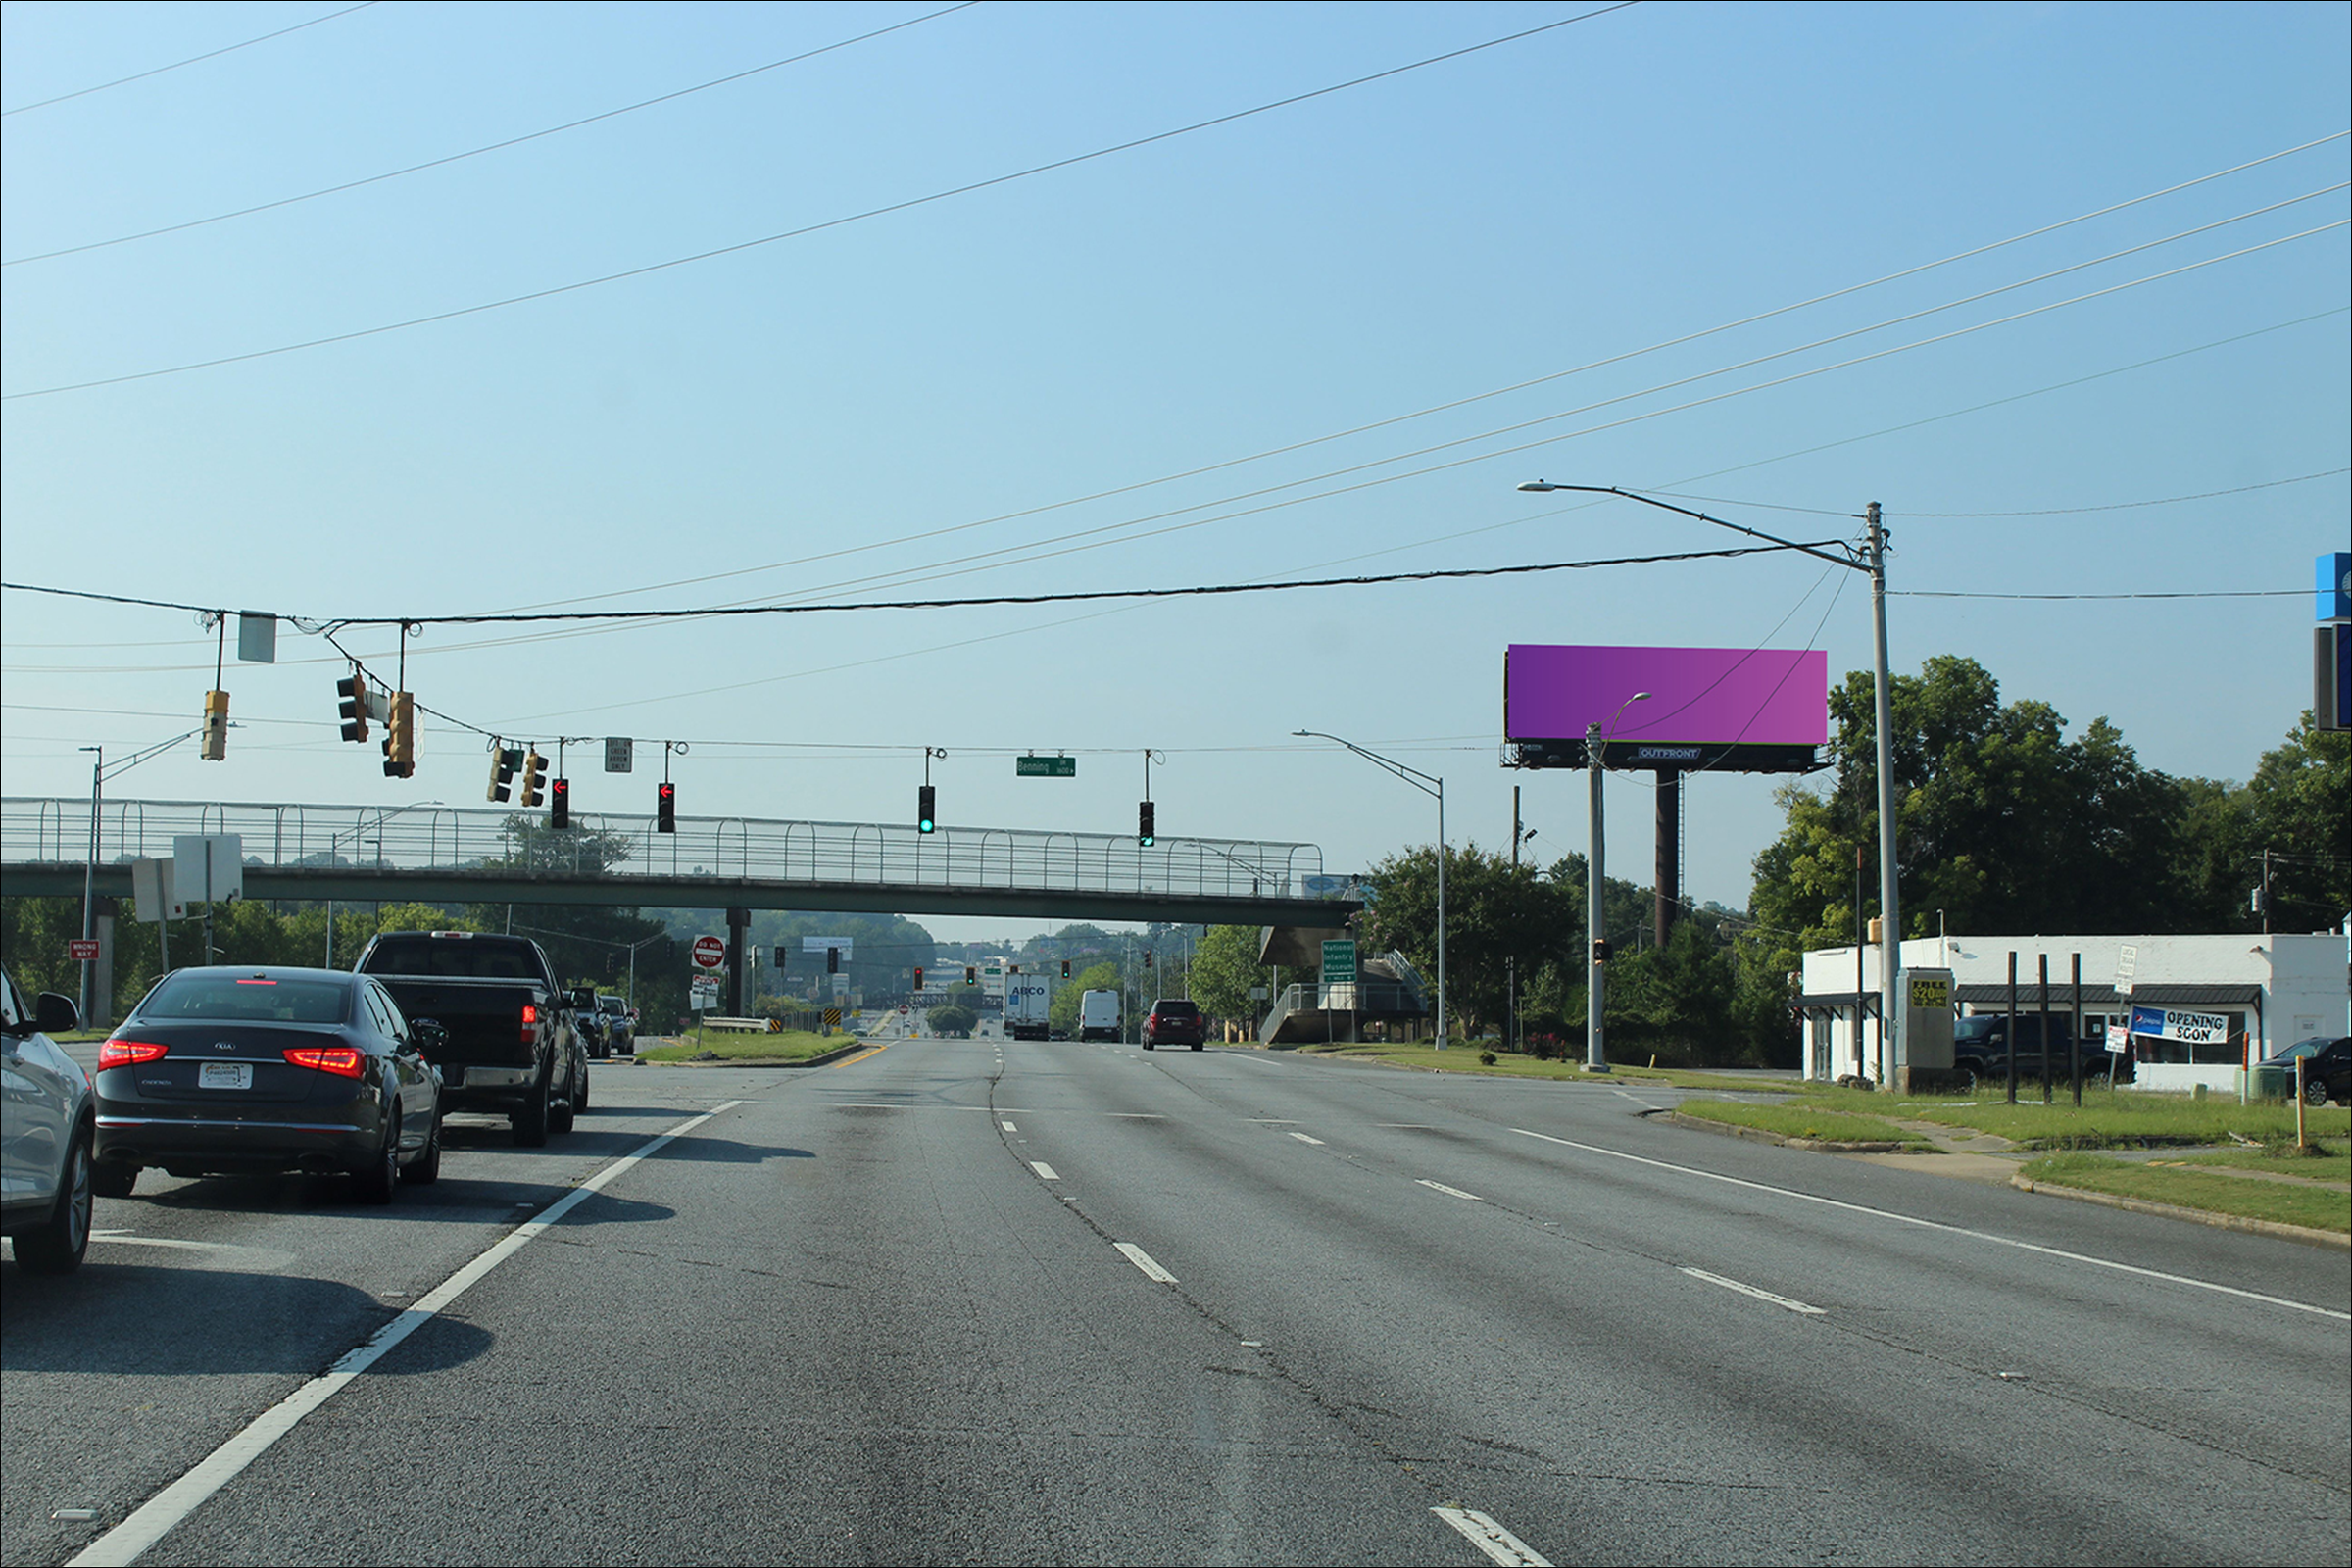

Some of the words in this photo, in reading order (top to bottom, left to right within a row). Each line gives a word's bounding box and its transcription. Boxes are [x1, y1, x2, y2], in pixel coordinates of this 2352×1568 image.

[1641, 748, 1698, 759] OUTFRONT
[1017, 760, 1049, 774] Benning
[1011, 986, 1045, 996] ABCO
[1913, 988, 1936, 999] $20
[2142, 1017, 2161, 1026] pepsi
[2167, 1011, 2224, 1030] OPENING
[2177, 1026, 2211, 1041] SOON
